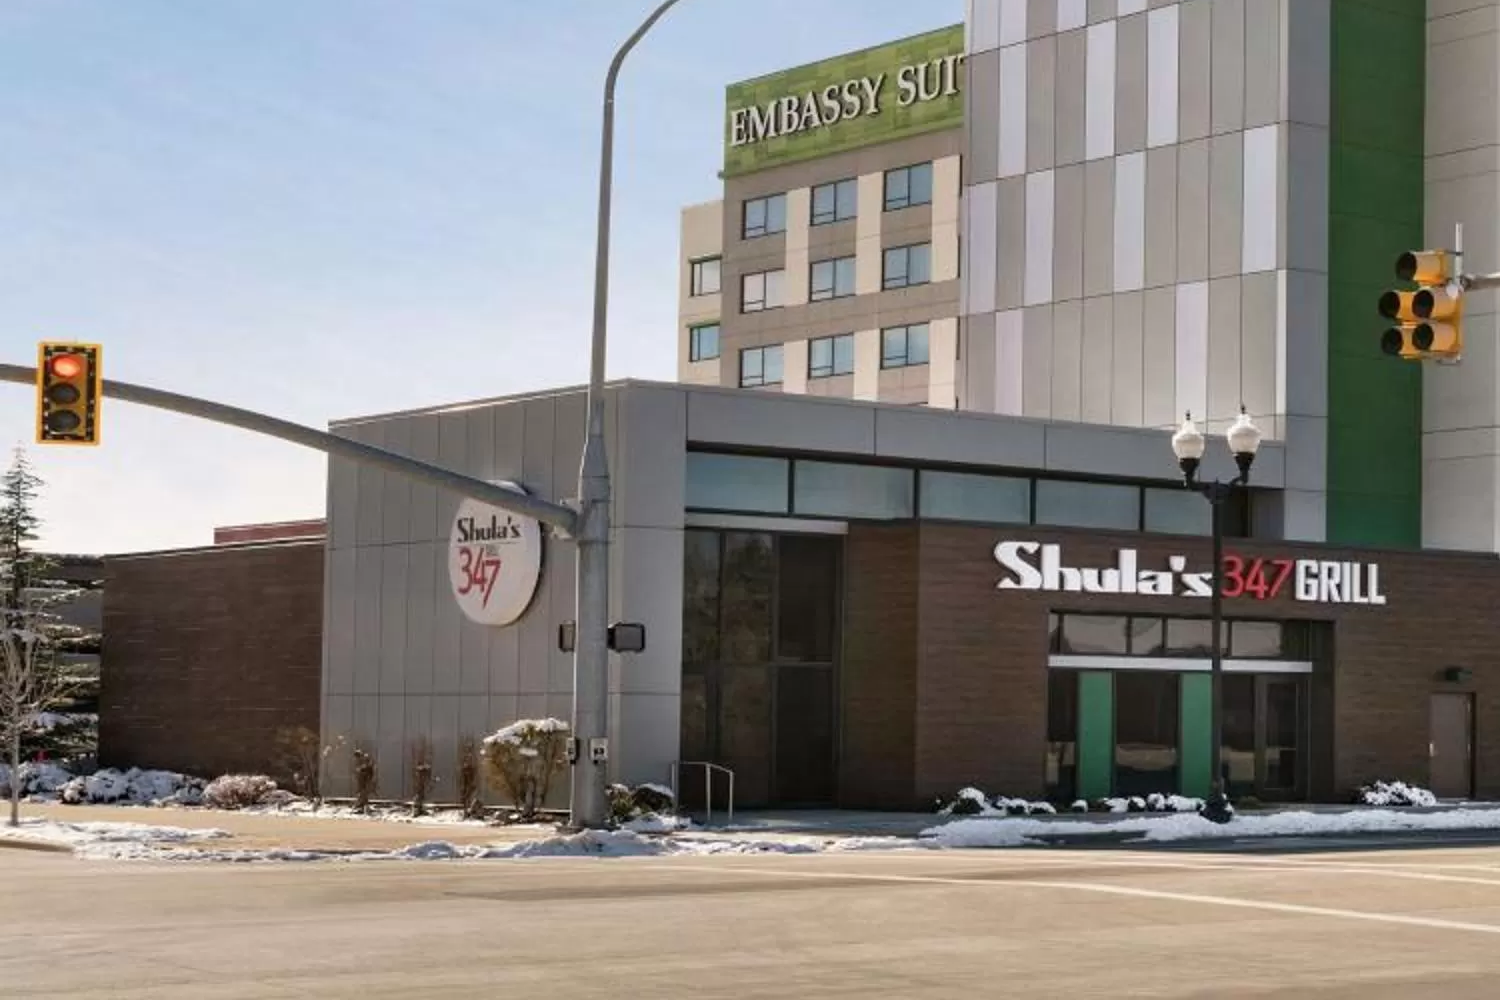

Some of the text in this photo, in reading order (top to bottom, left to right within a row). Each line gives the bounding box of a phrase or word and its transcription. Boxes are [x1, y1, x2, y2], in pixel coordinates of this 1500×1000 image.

[730, 53, 966, 147] EMBASSY SUI
[457, 513, 522, 543] Shula's
[457, 545, 502, 610] 347
[992, 540, 1387, 606] Shula's 347 GRILL
